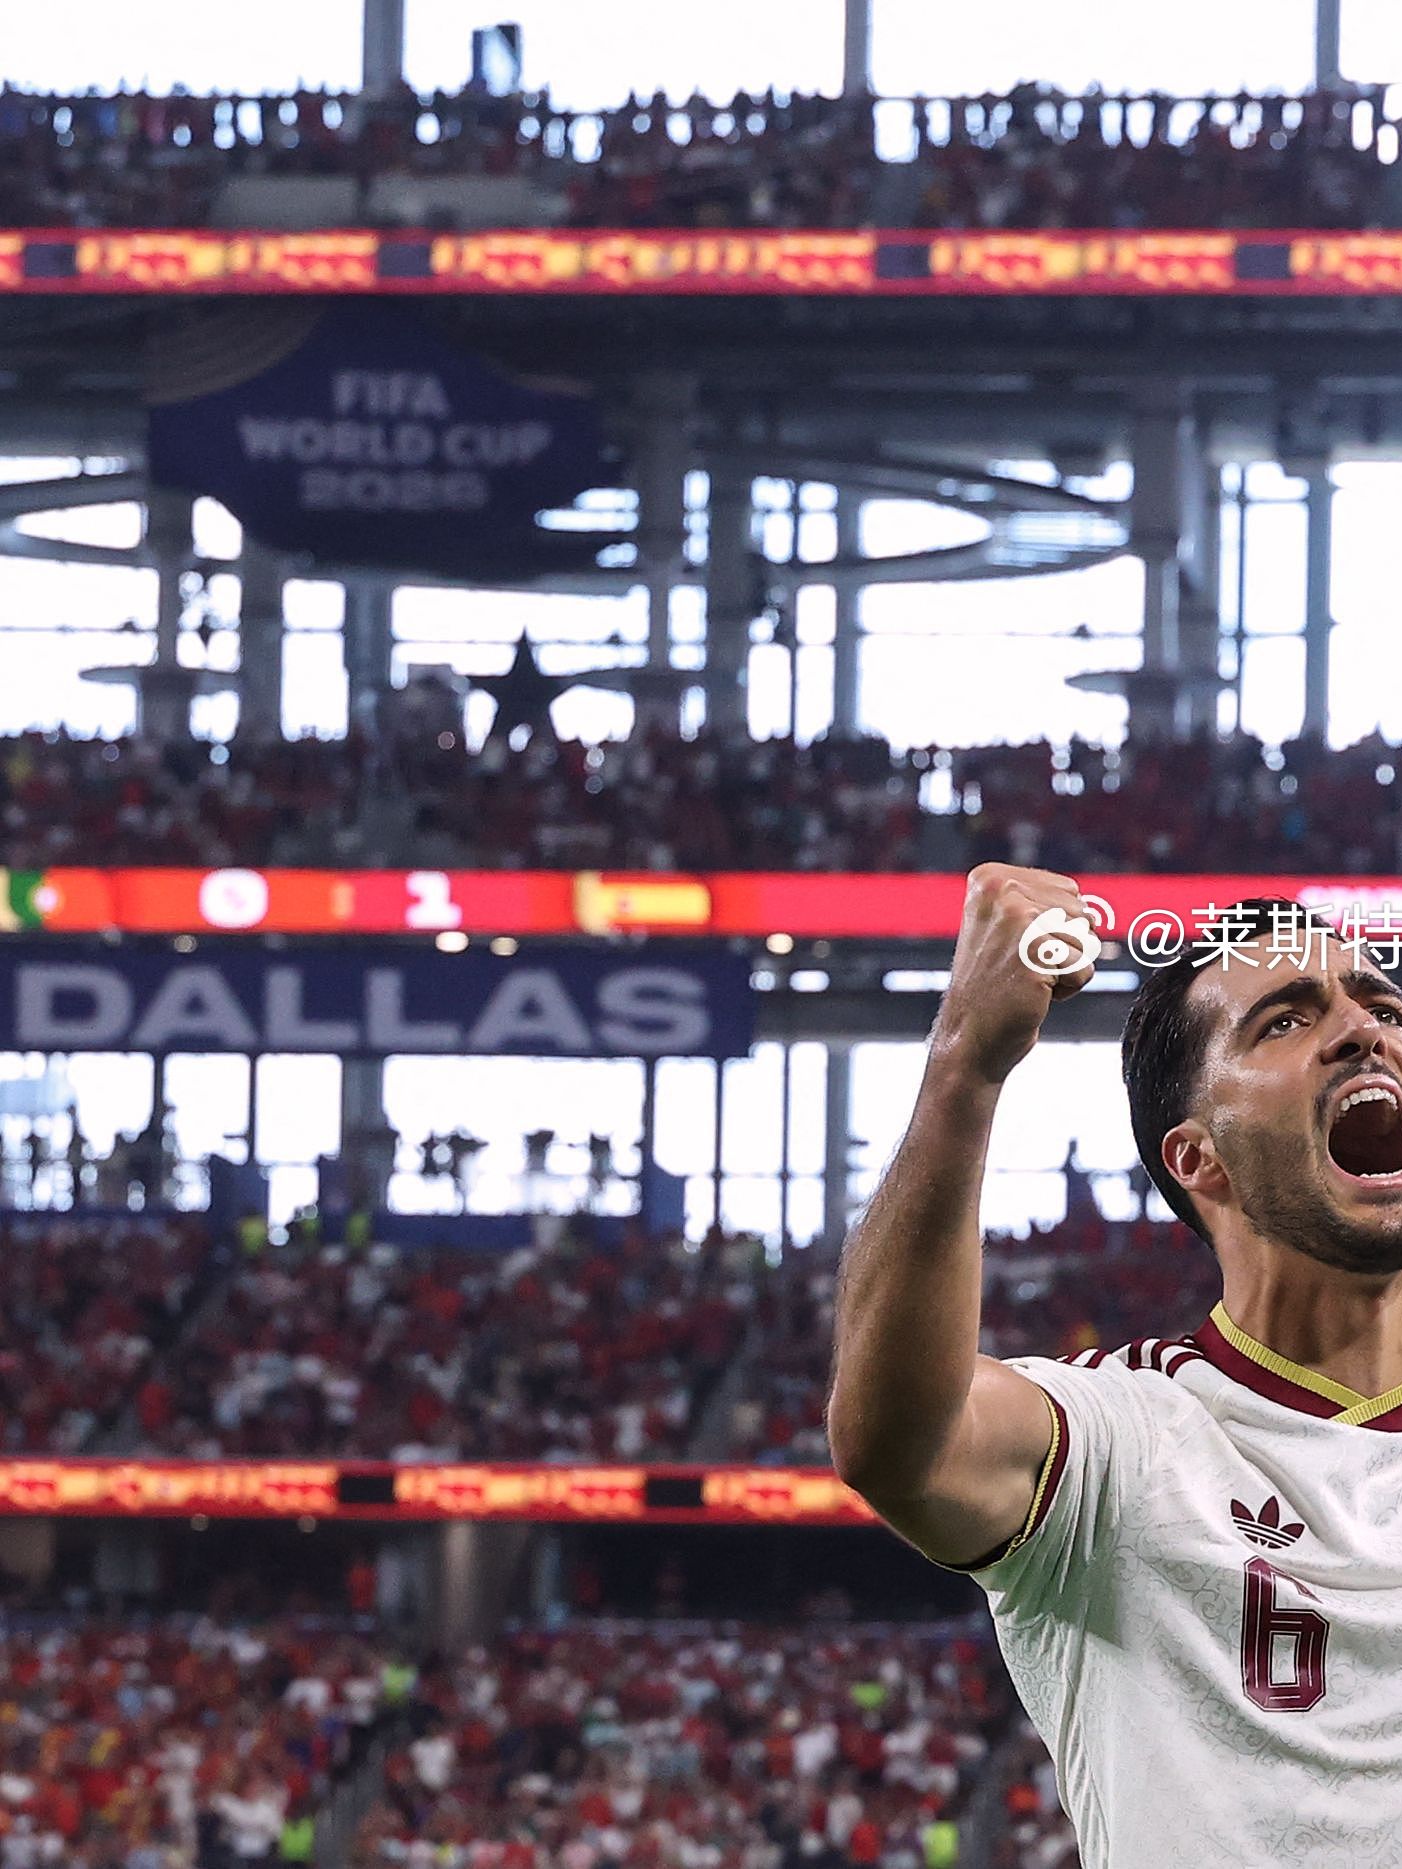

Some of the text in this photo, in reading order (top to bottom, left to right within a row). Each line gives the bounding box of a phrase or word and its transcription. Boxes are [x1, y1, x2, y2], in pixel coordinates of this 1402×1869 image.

[333, 371, 447, 418] FIFA
[240, 417, 551, 468] WORLD CUP
[406, 869, 461, 930] 1
[13, 963, 712, 1053] DALLAS
[1241, 1555, 1329, 1713] 6
